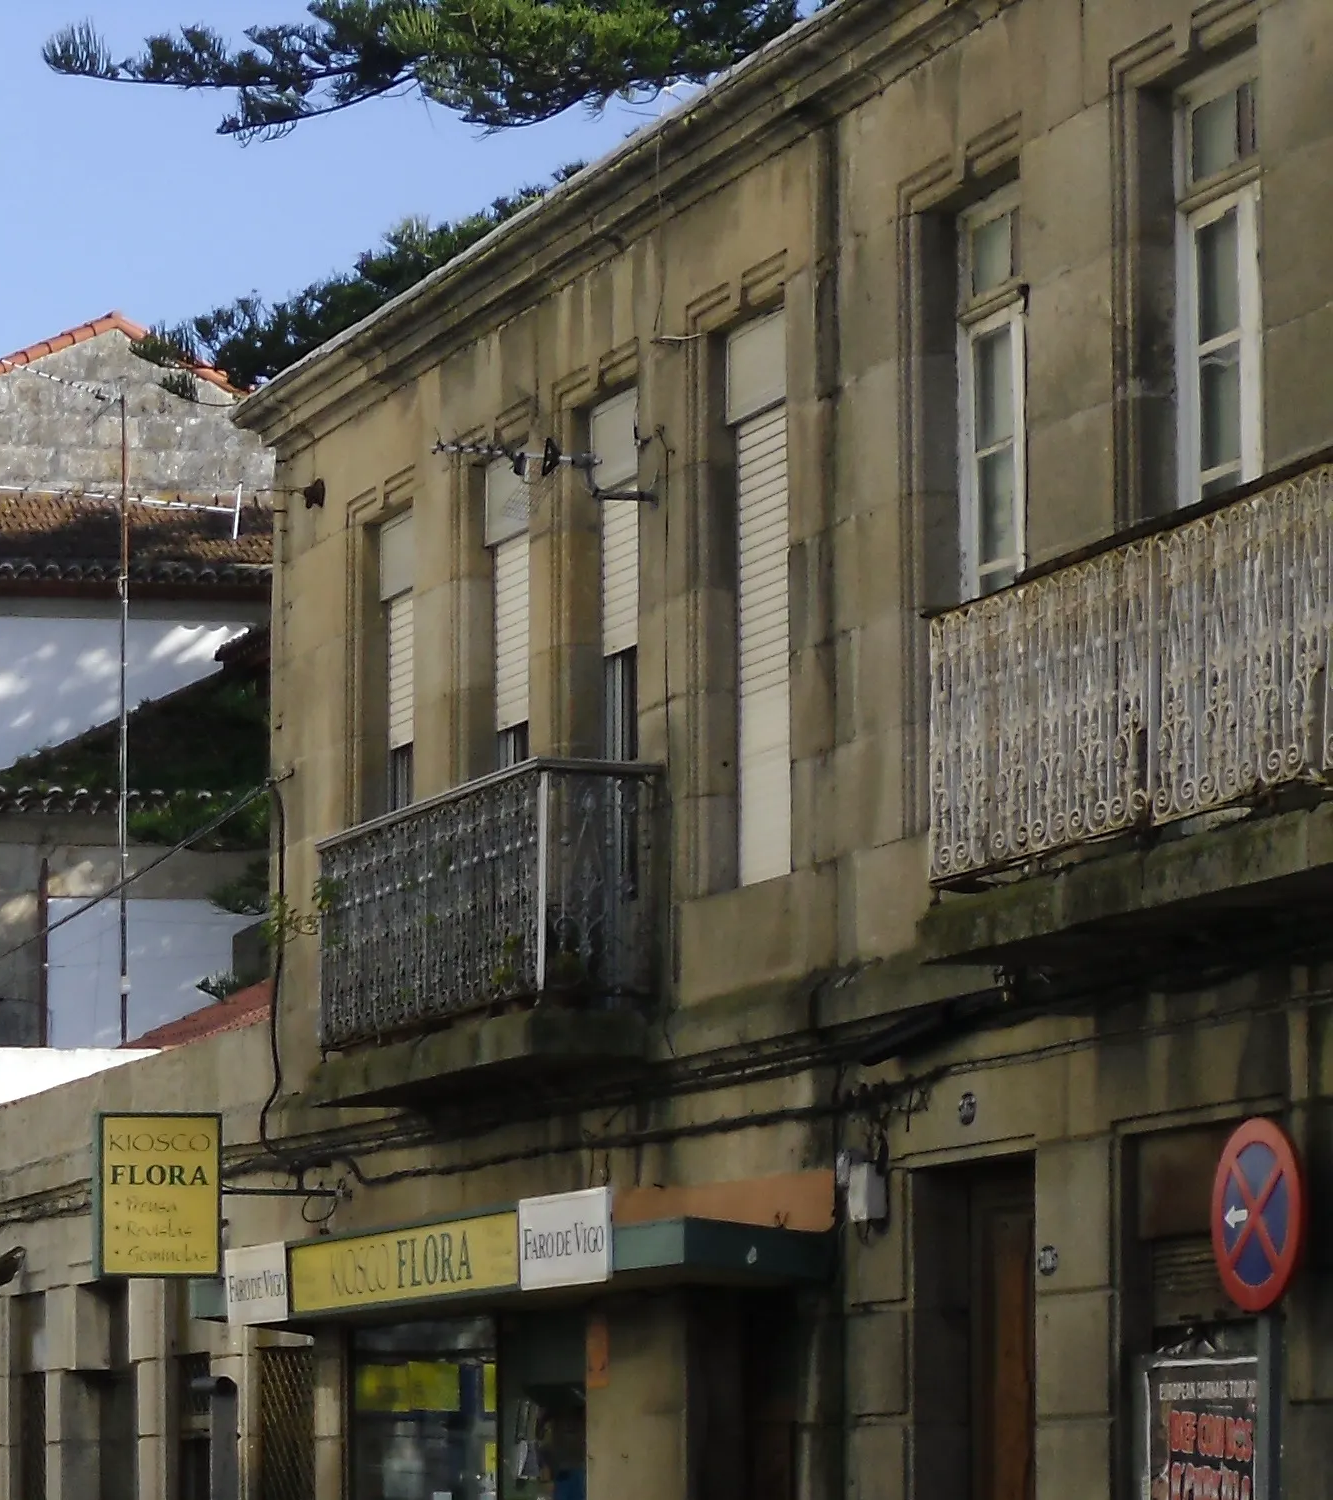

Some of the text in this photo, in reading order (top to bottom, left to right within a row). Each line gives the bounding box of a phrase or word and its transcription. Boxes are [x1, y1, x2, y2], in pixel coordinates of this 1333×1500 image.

[110, 1133, 211, 1152] KIOSCO
[111, 1164, 210, 1186] FLORA
[396, 1231, 473, 1289] FLORA
